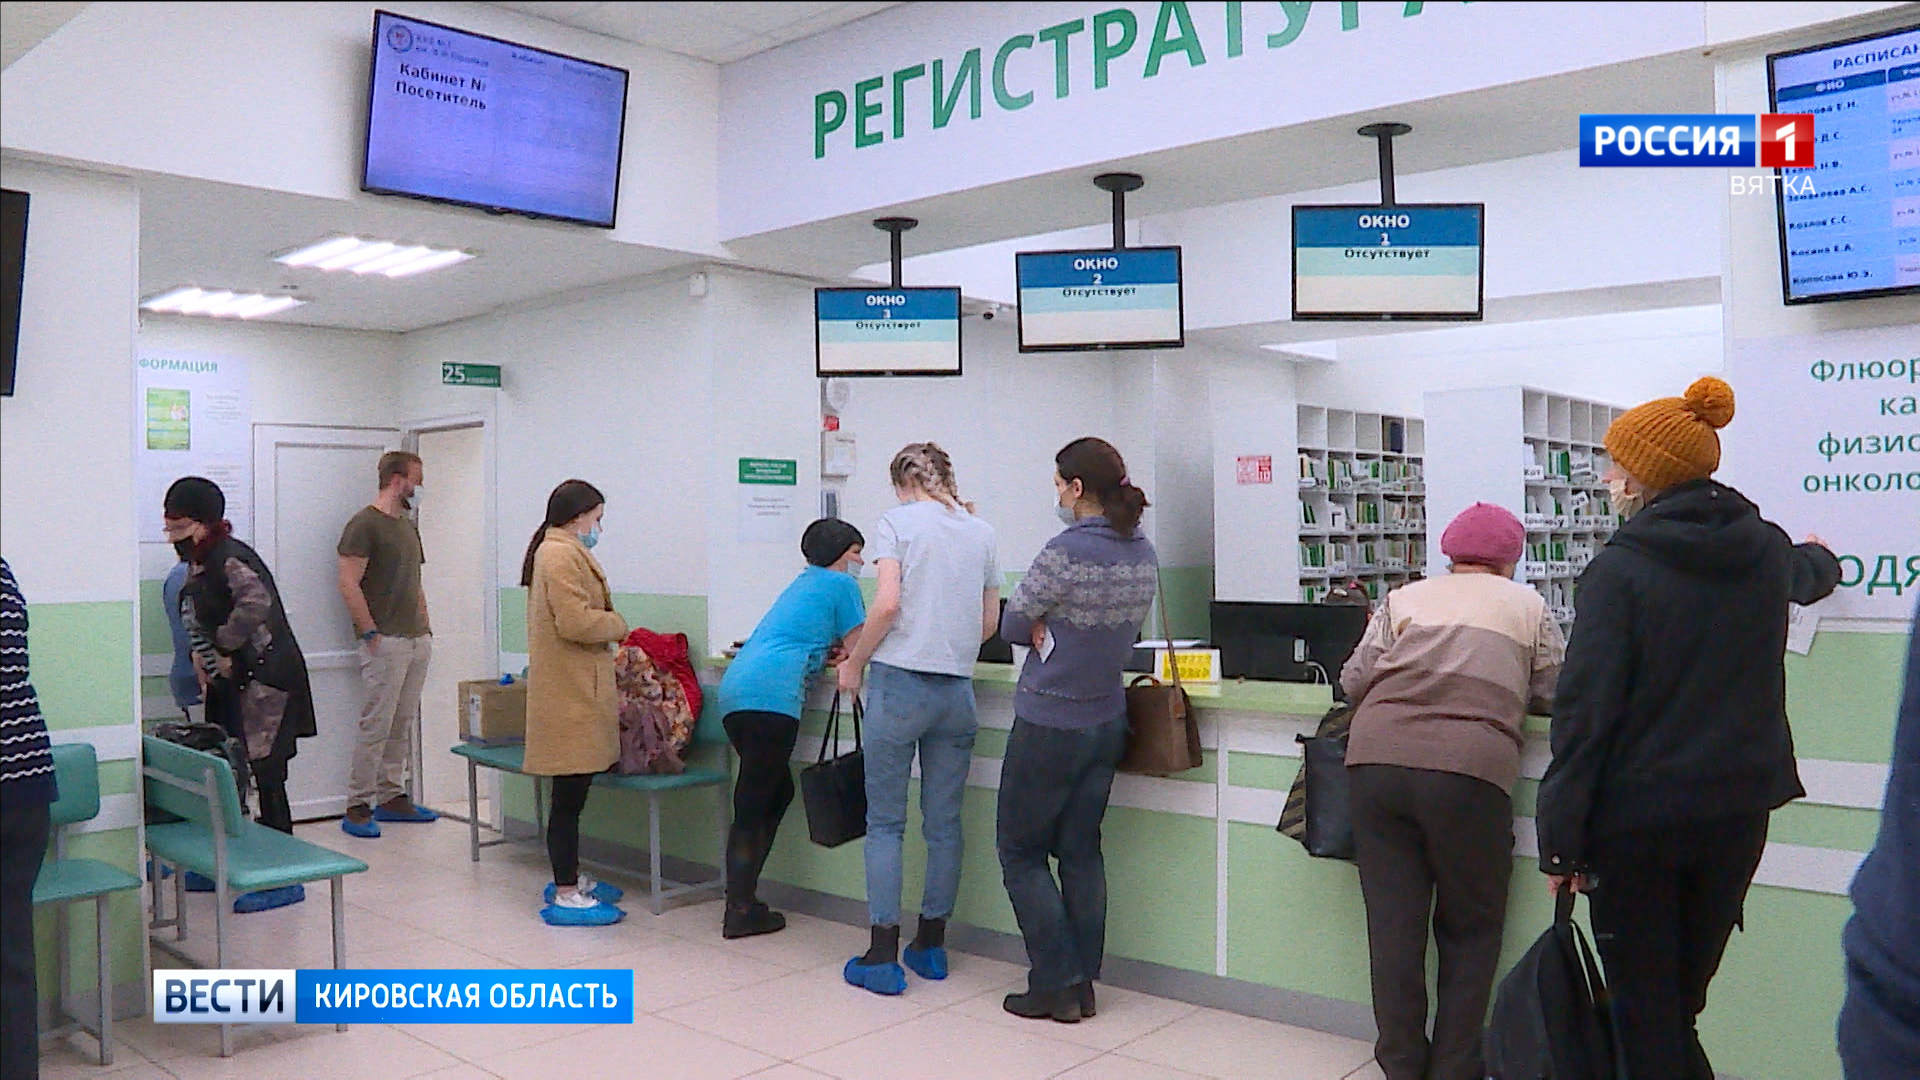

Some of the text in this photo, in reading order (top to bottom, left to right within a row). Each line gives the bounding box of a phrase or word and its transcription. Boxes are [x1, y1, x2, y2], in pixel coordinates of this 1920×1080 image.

[400, 63, 466, 88] Кабинет
[814, 2, 1469, 159] РЕГИСТРАТУ
[1815, 78, 1846, 92] ФИО
[396, 80, 487, 110] Посетитель
[1358, 214, 1410, 229] ОКНО
[1380, 232, 1391, 246] 1
[1344, 249, 1431, 260] Отсутствует
[1073, 257, 1119, 271] ОКНО
[1092, 273, 1103, 285] 2
[1062, 287, 1137, 298] Отсутствует
[865, 294, 907, 307] ОКНО
[139, 357, 219, 374] ФОРМАЦИЯ
[443, 364, 466, 382] 25
